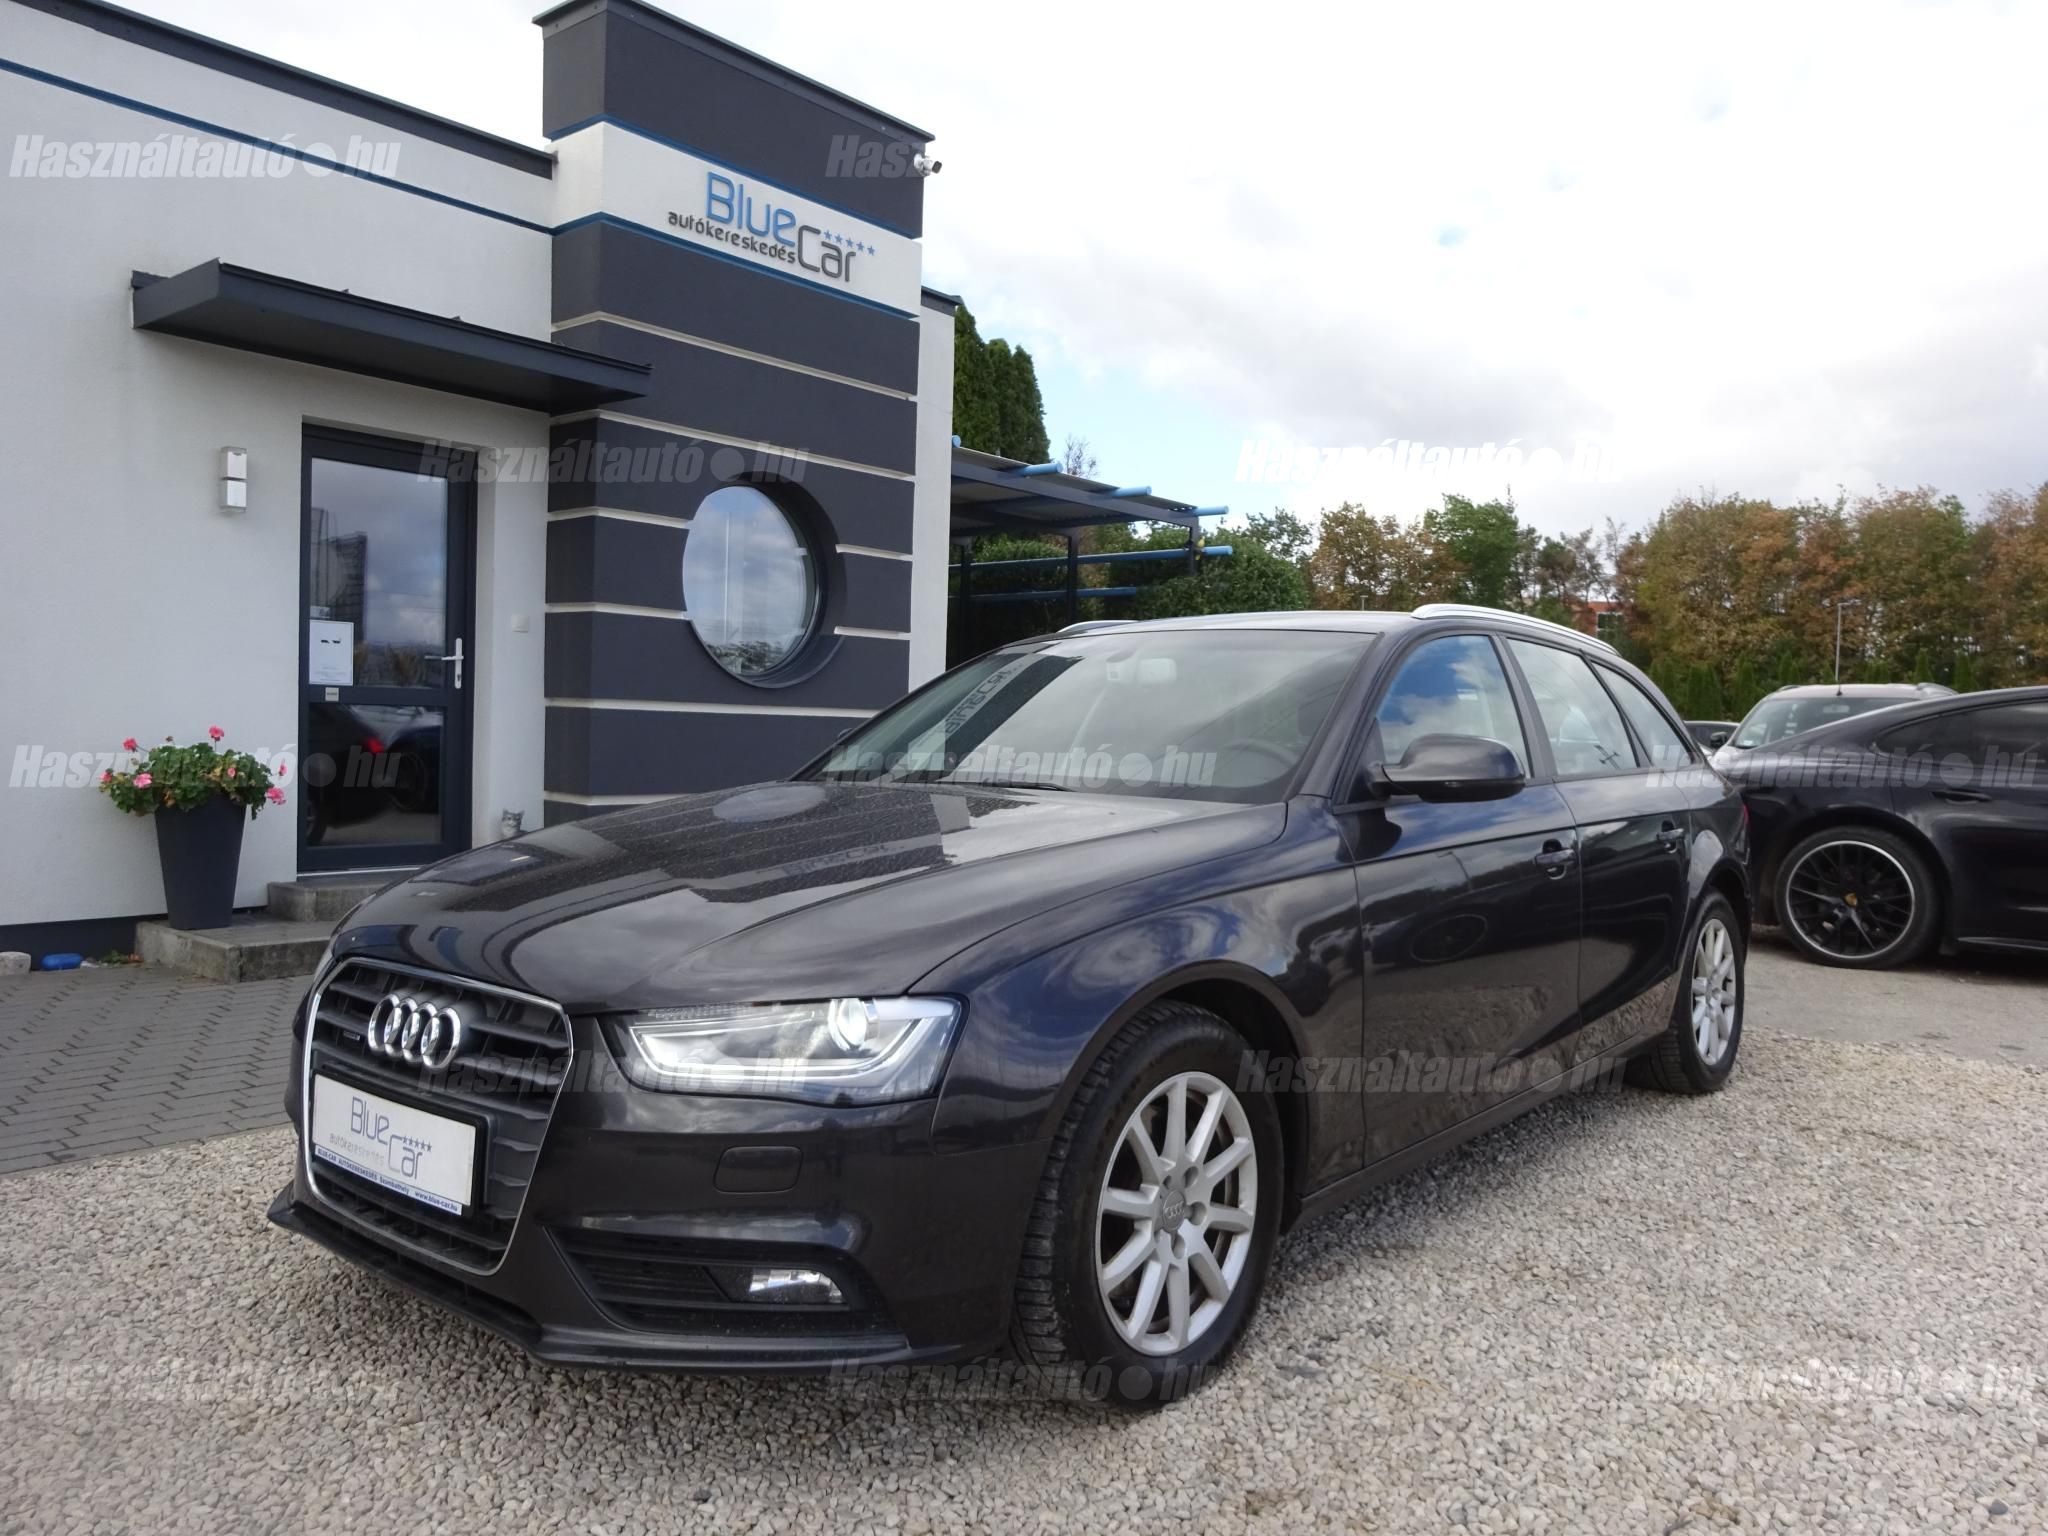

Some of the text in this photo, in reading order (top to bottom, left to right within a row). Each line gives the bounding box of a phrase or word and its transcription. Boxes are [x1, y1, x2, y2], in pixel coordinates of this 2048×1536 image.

[668, 211, 796, 264] autókereskedés
[706, 171, 856, 282] Blue Car
[350, 1095, 423, 1180] Blue Car
